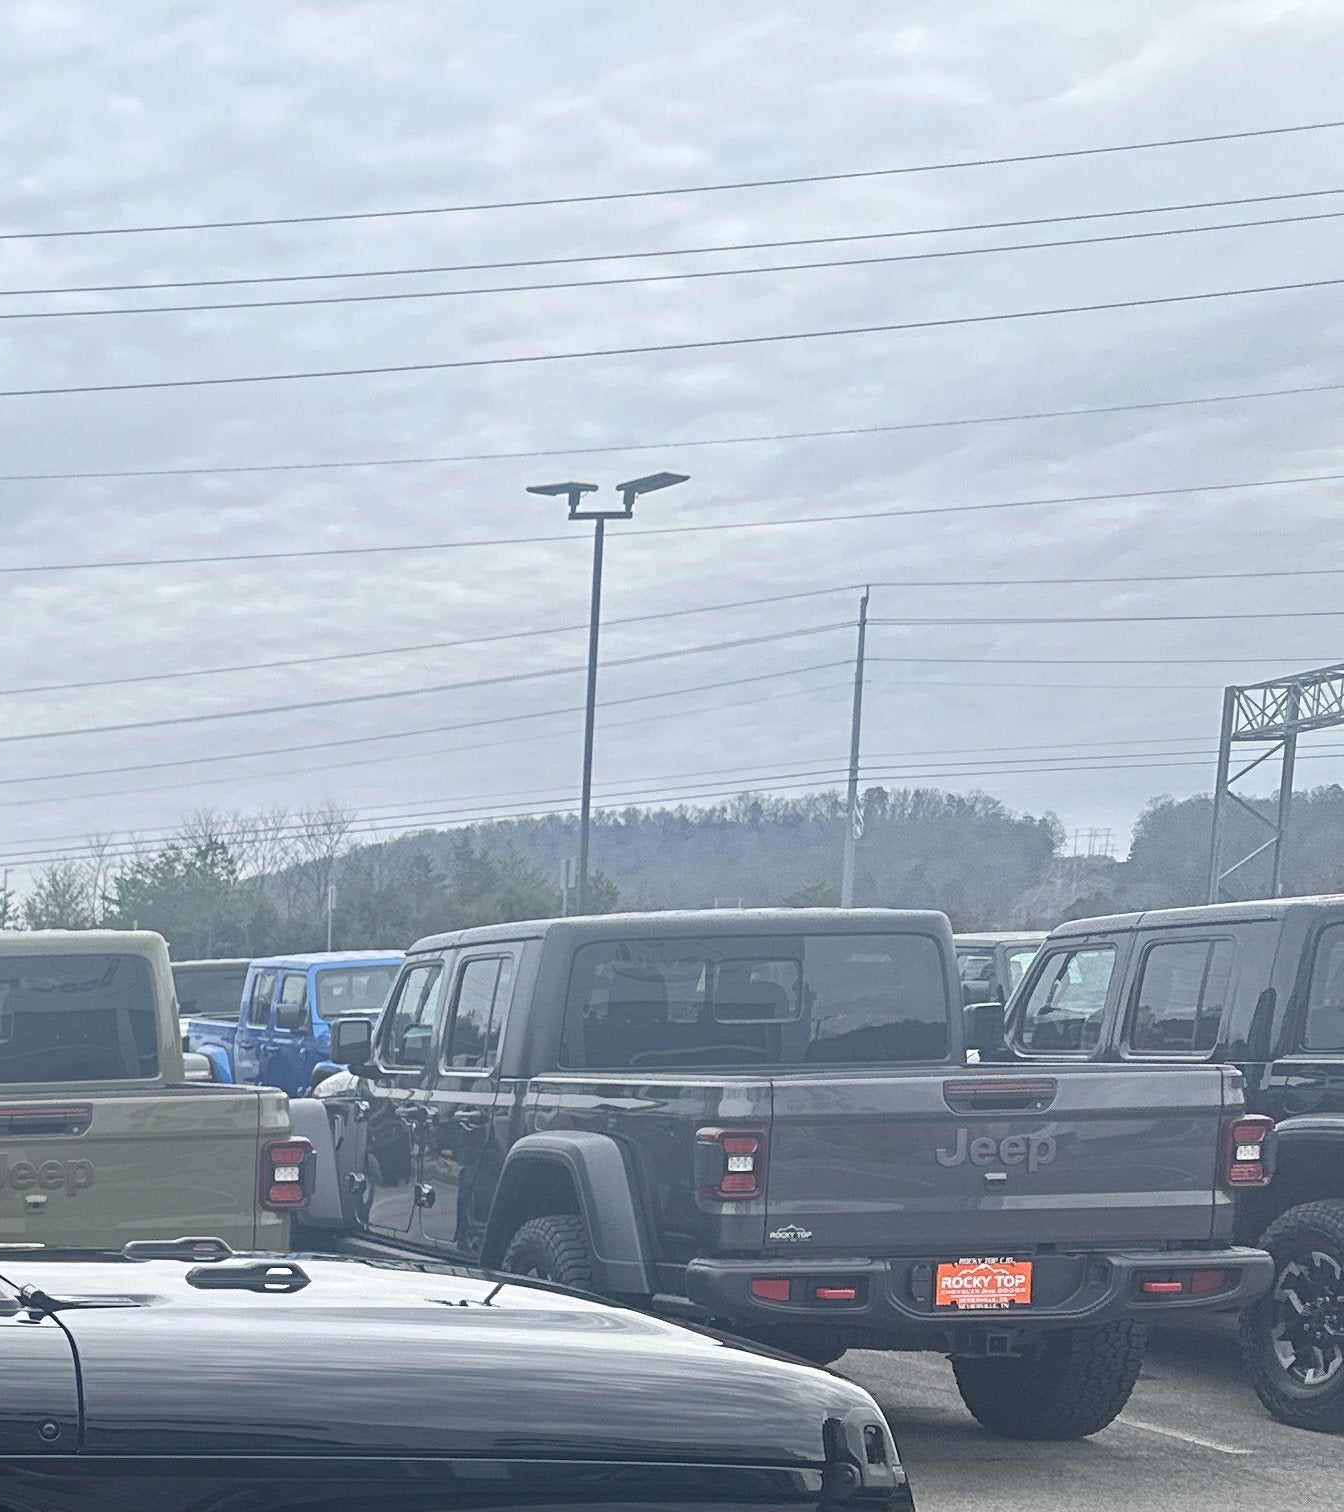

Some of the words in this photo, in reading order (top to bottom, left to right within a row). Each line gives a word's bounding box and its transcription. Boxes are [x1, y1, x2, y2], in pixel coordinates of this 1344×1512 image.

[936, 1128, 1057, 1173] Jeep
[769, 1231, 795, 1239] ROCKY
[940, 1276, 992, 1289] ROCKY
[994, 1274, 1026, 1288] TOP
